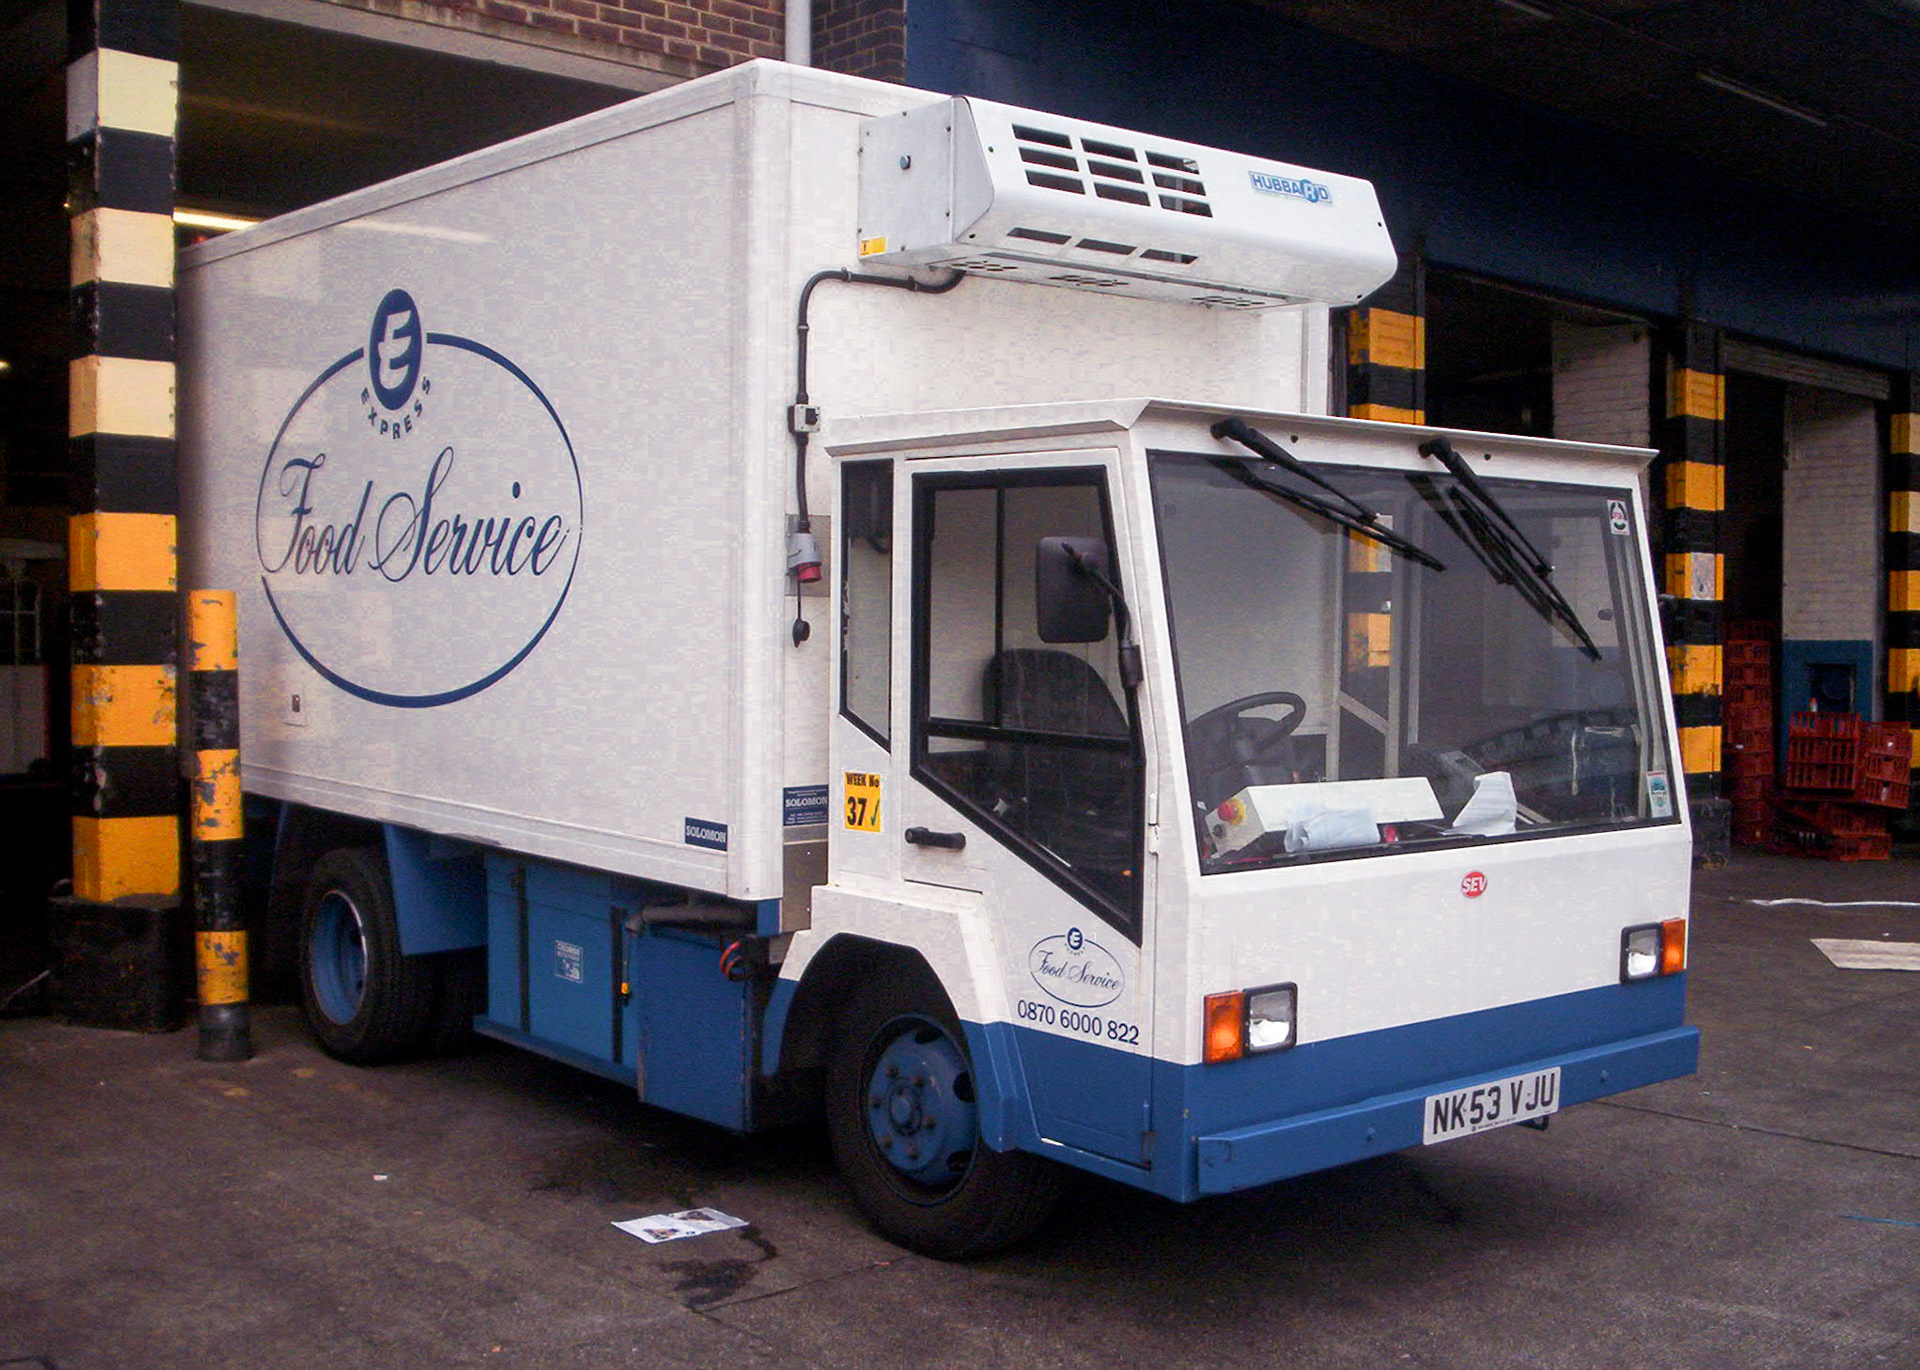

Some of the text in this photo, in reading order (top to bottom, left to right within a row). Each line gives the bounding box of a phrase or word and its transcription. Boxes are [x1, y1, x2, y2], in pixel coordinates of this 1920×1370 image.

[1251, 174, 1329, 203] HUBBARD
[360, 376, 432, 439] EXPRESS
[264, 446, 571, 582] Food Service
[845, 772, 867, 787] WEEK
[785, 797, 828, 808] SOLOMON
[846, 796, 868, 826] 37
[685, 825, 727, 843] SOLOMON
[1462, 876, 1487, 892] SEV
[1036, 950, 1120, 990] Food Service
[1017, 1000, 1139, 1045] 0870 6000 822
[1433, 1073, 1555, 1134] NK53 VJU
